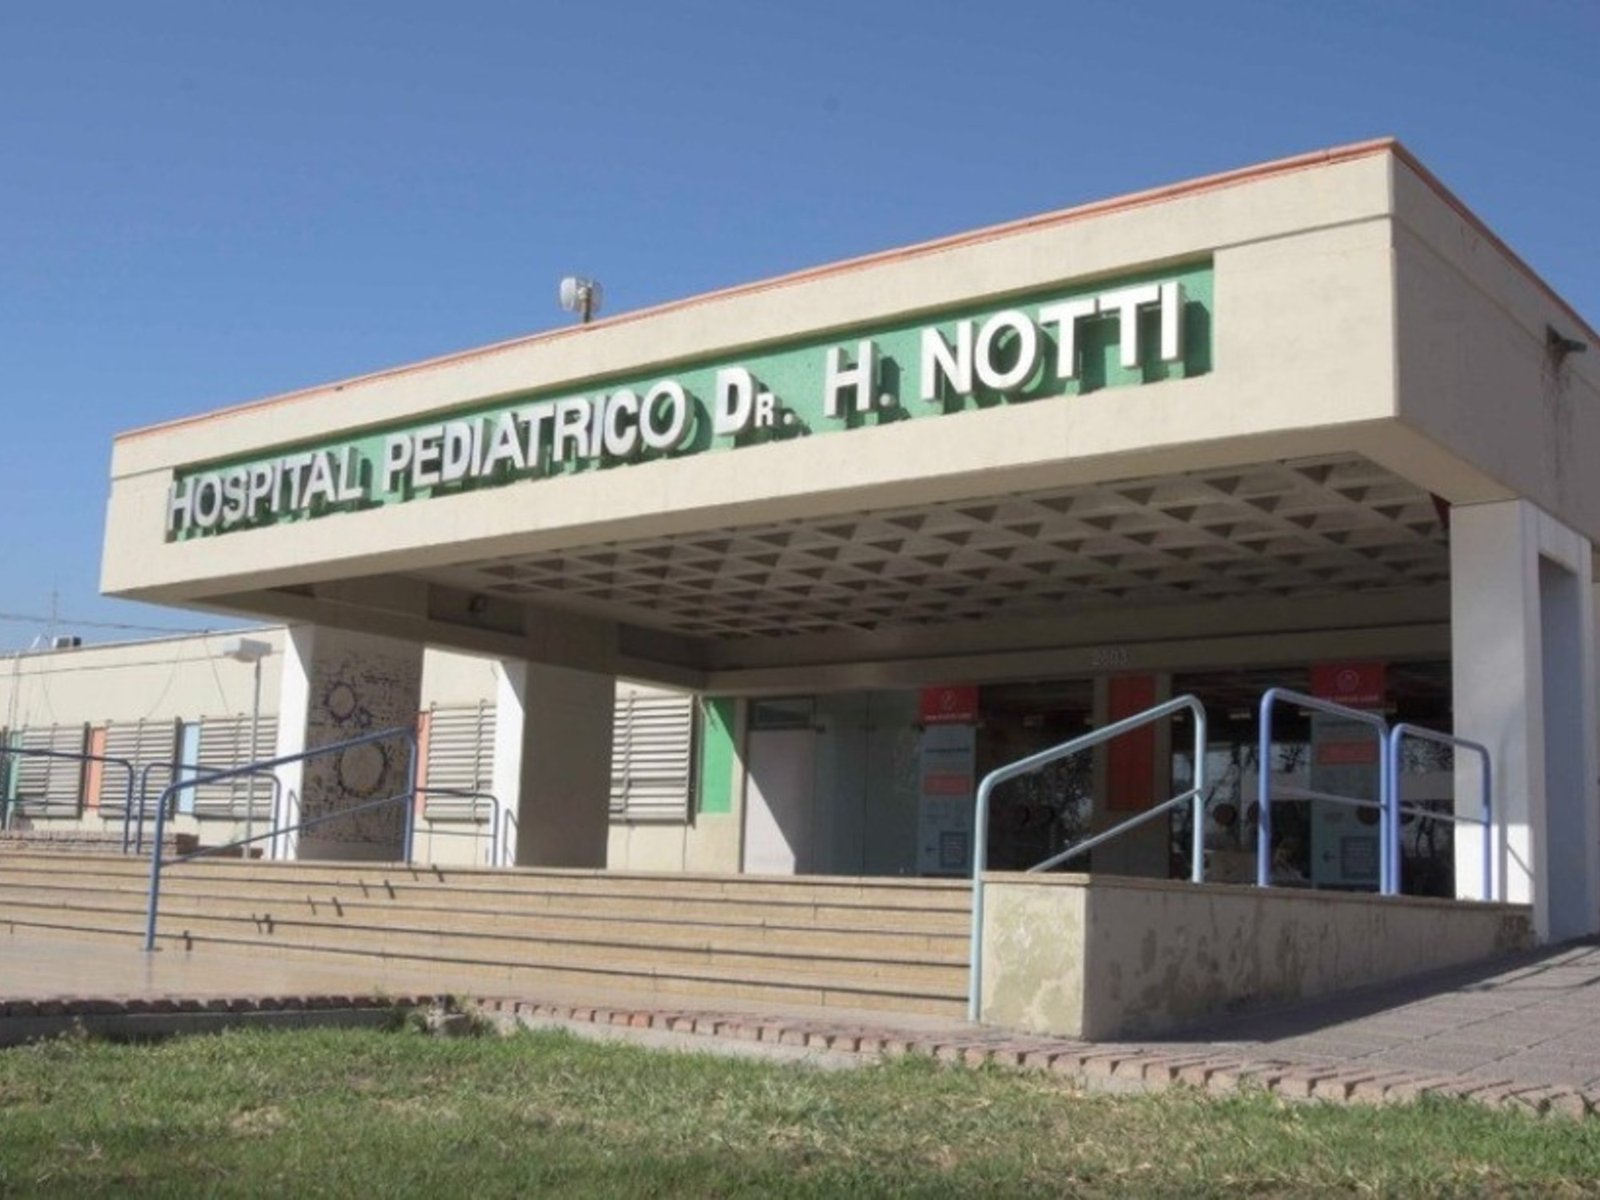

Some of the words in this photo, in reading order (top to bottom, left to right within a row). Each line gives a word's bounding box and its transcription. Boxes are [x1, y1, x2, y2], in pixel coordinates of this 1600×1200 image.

[166, 446, 363, 531] HOSPITAL
[382, 380, 691, 492] PEDIATRICO
[824, 340, 897, 418] H.
[920, 281, 1184, 401] NOTTI
